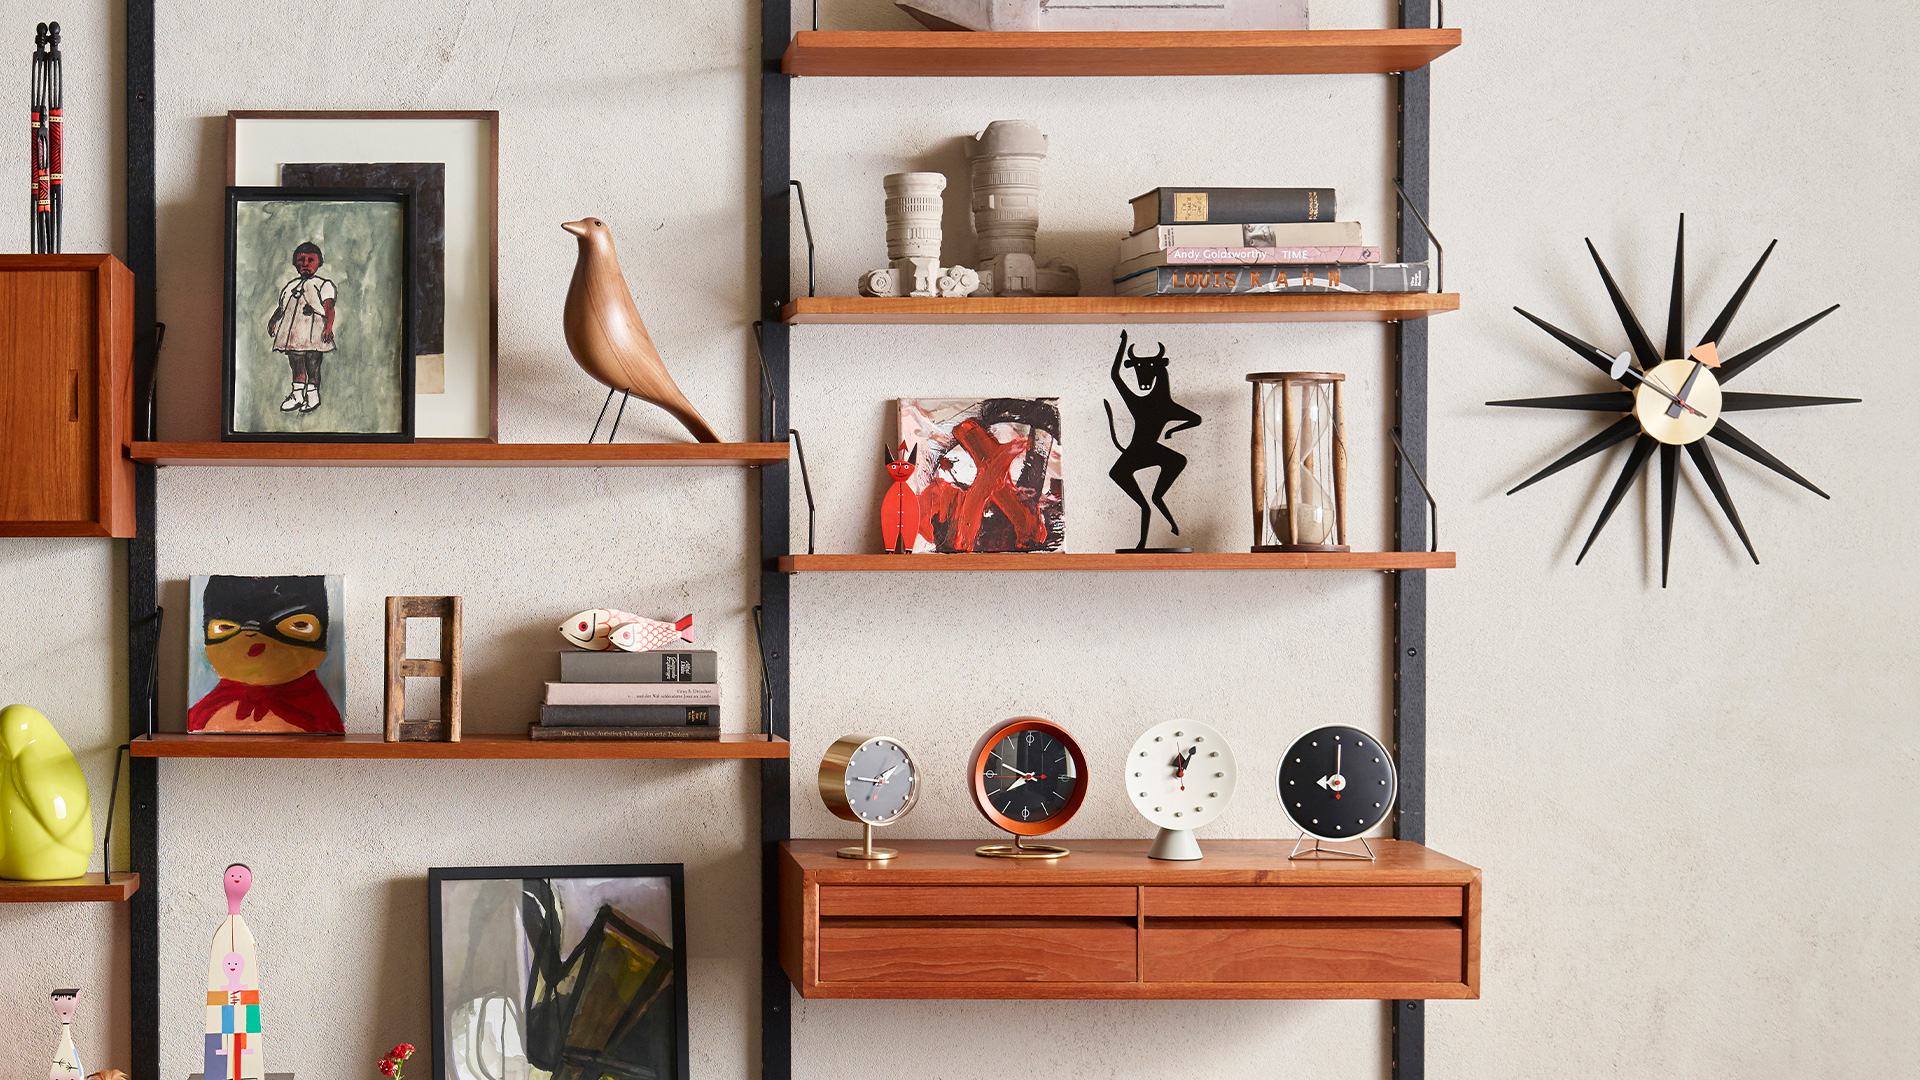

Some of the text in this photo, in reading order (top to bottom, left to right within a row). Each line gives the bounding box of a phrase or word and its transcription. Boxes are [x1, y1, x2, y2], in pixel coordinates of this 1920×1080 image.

[1173, 249, 1267, 261] Andy Goldsworthy
[1282, 250, 1308, 259] TIME
[1172, 271, 1236, 288] LOUIS
